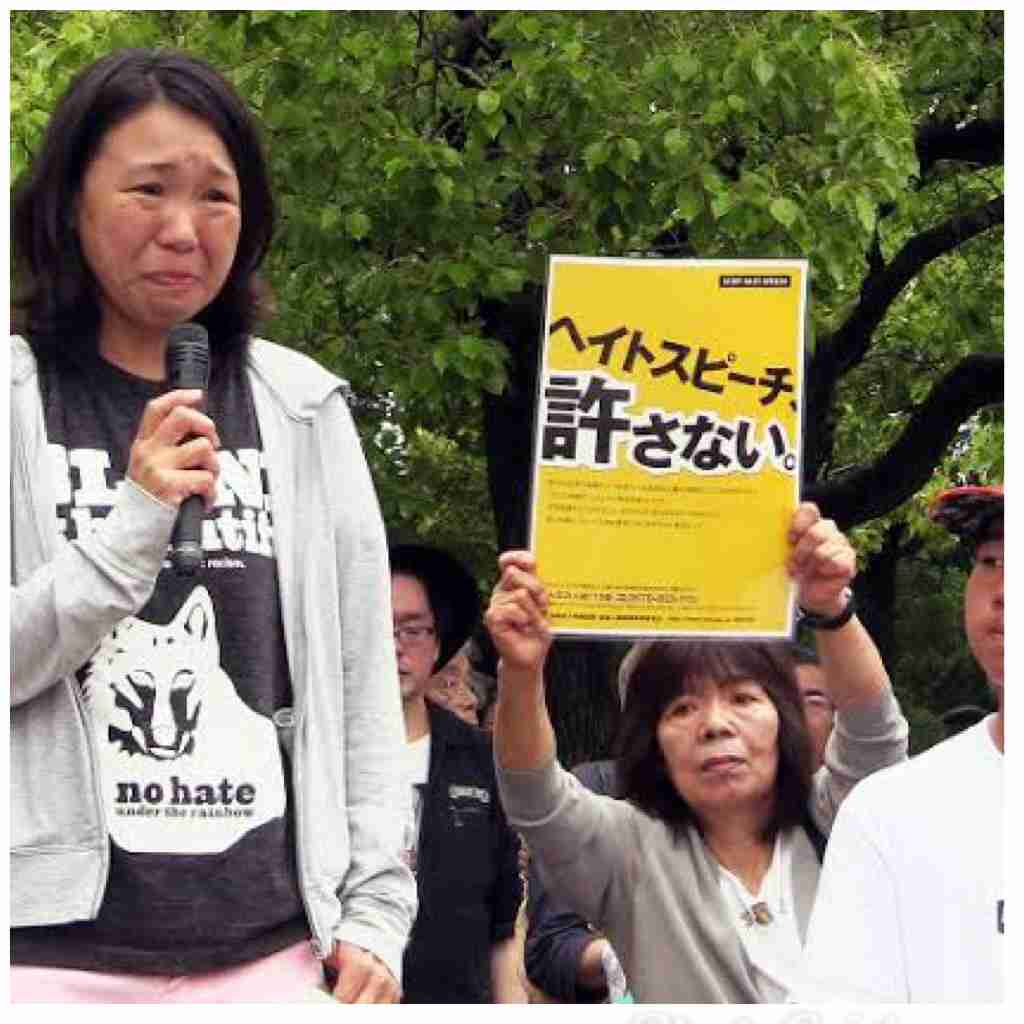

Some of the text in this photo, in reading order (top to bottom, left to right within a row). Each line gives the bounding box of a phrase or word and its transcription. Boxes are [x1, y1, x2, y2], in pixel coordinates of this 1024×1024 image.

[542, 377, 797, 471] 許さない。
[116, 776, 256, 806] no hate
